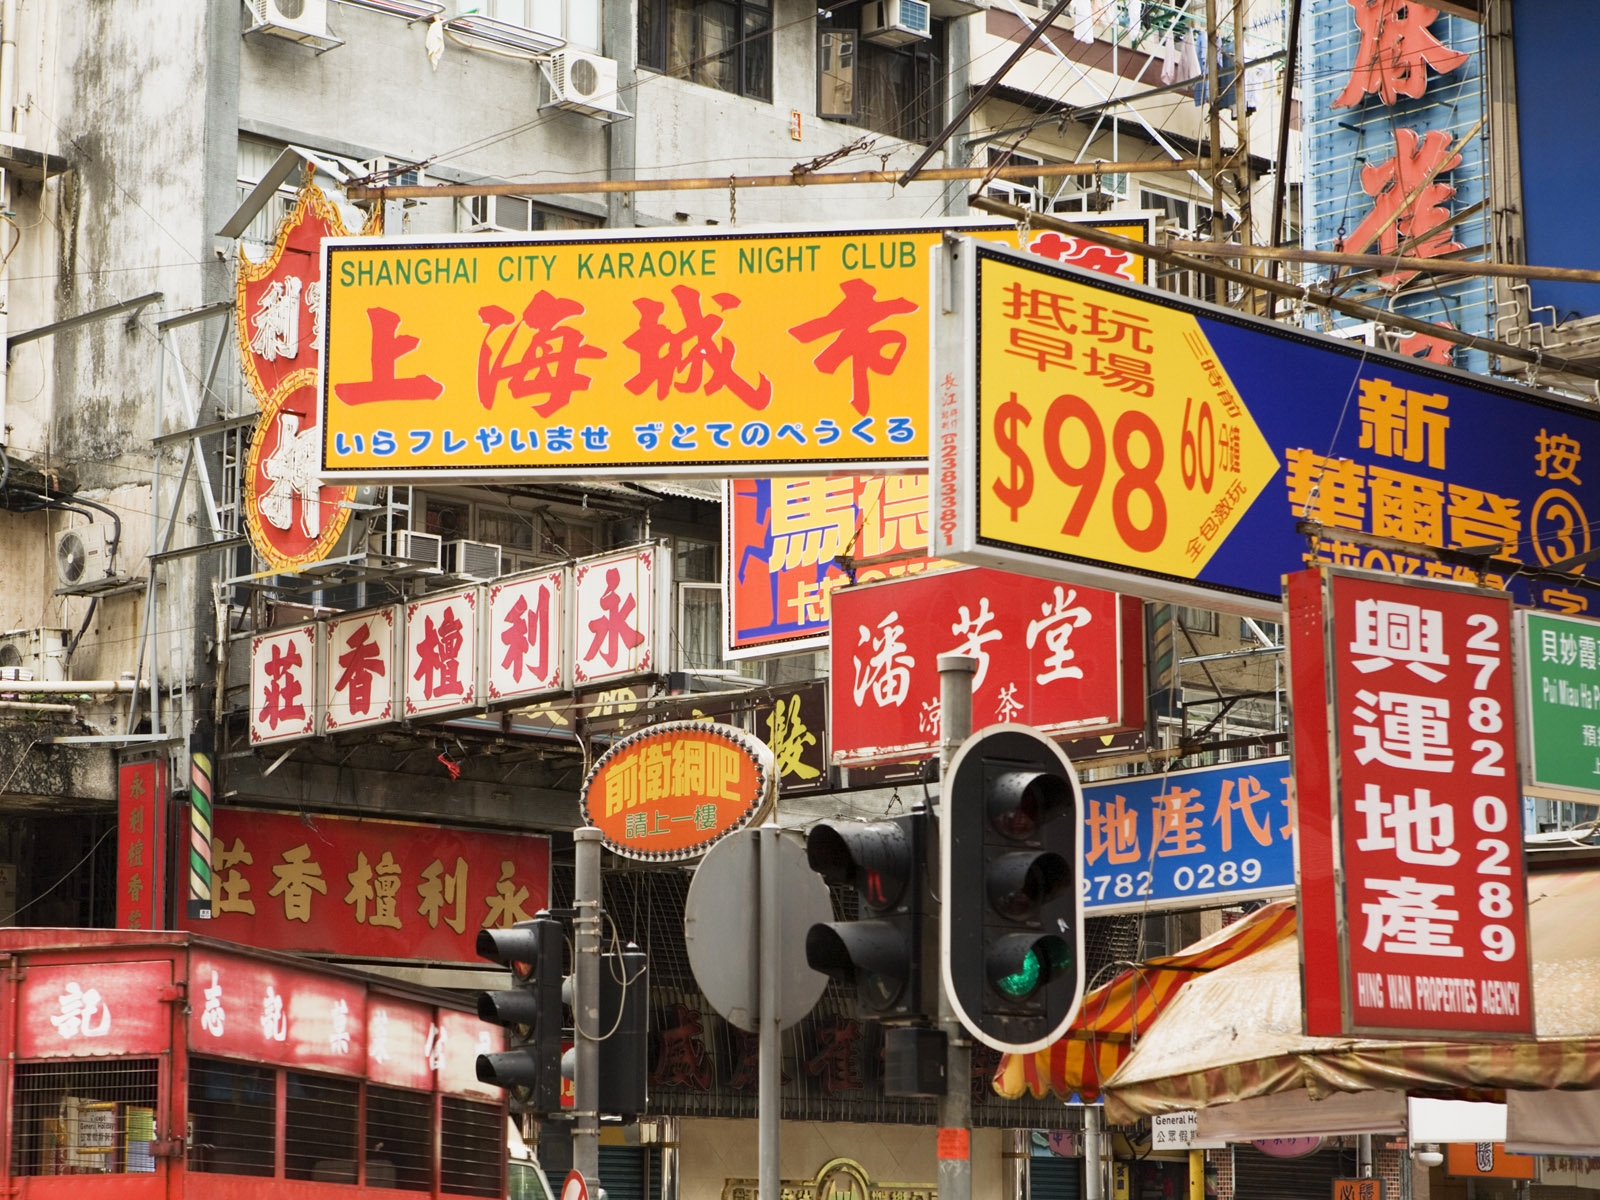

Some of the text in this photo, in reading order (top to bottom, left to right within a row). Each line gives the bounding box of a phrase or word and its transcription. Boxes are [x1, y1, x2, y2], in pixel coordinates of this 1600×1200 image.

[340, 241, 917, 287] SHANGHAI CITY KARAOKE NIGHT CLUB
[334, 278, 920, 419] 上海城市
[1002, 281, 1154, 355] 抵玩
[1004, 327, 1155, 398] 早場
[335, 425, 610, 456] いらフレやいませ
[1358, 378, 1450, 470] 新
[991, 391, 1168, 553] $98
[853, 586, 1092, 707] 潘芳堂
[1541, 629, 1600, 671] 貝妙霞
[605, 740, 741, 818] 前衛網吧
[1350, 598, 1465, 958] 興運地產
[625, 804, 717, 839] 請上一樓
[1085, 775, 1293, 867] 地產代
[1173, 858, 1262, 891] 0289
[1357, 972, 1520, 1016] HING WAN PROPERTIES AGENCY
[1155, 1115, 1187, 1126] General
